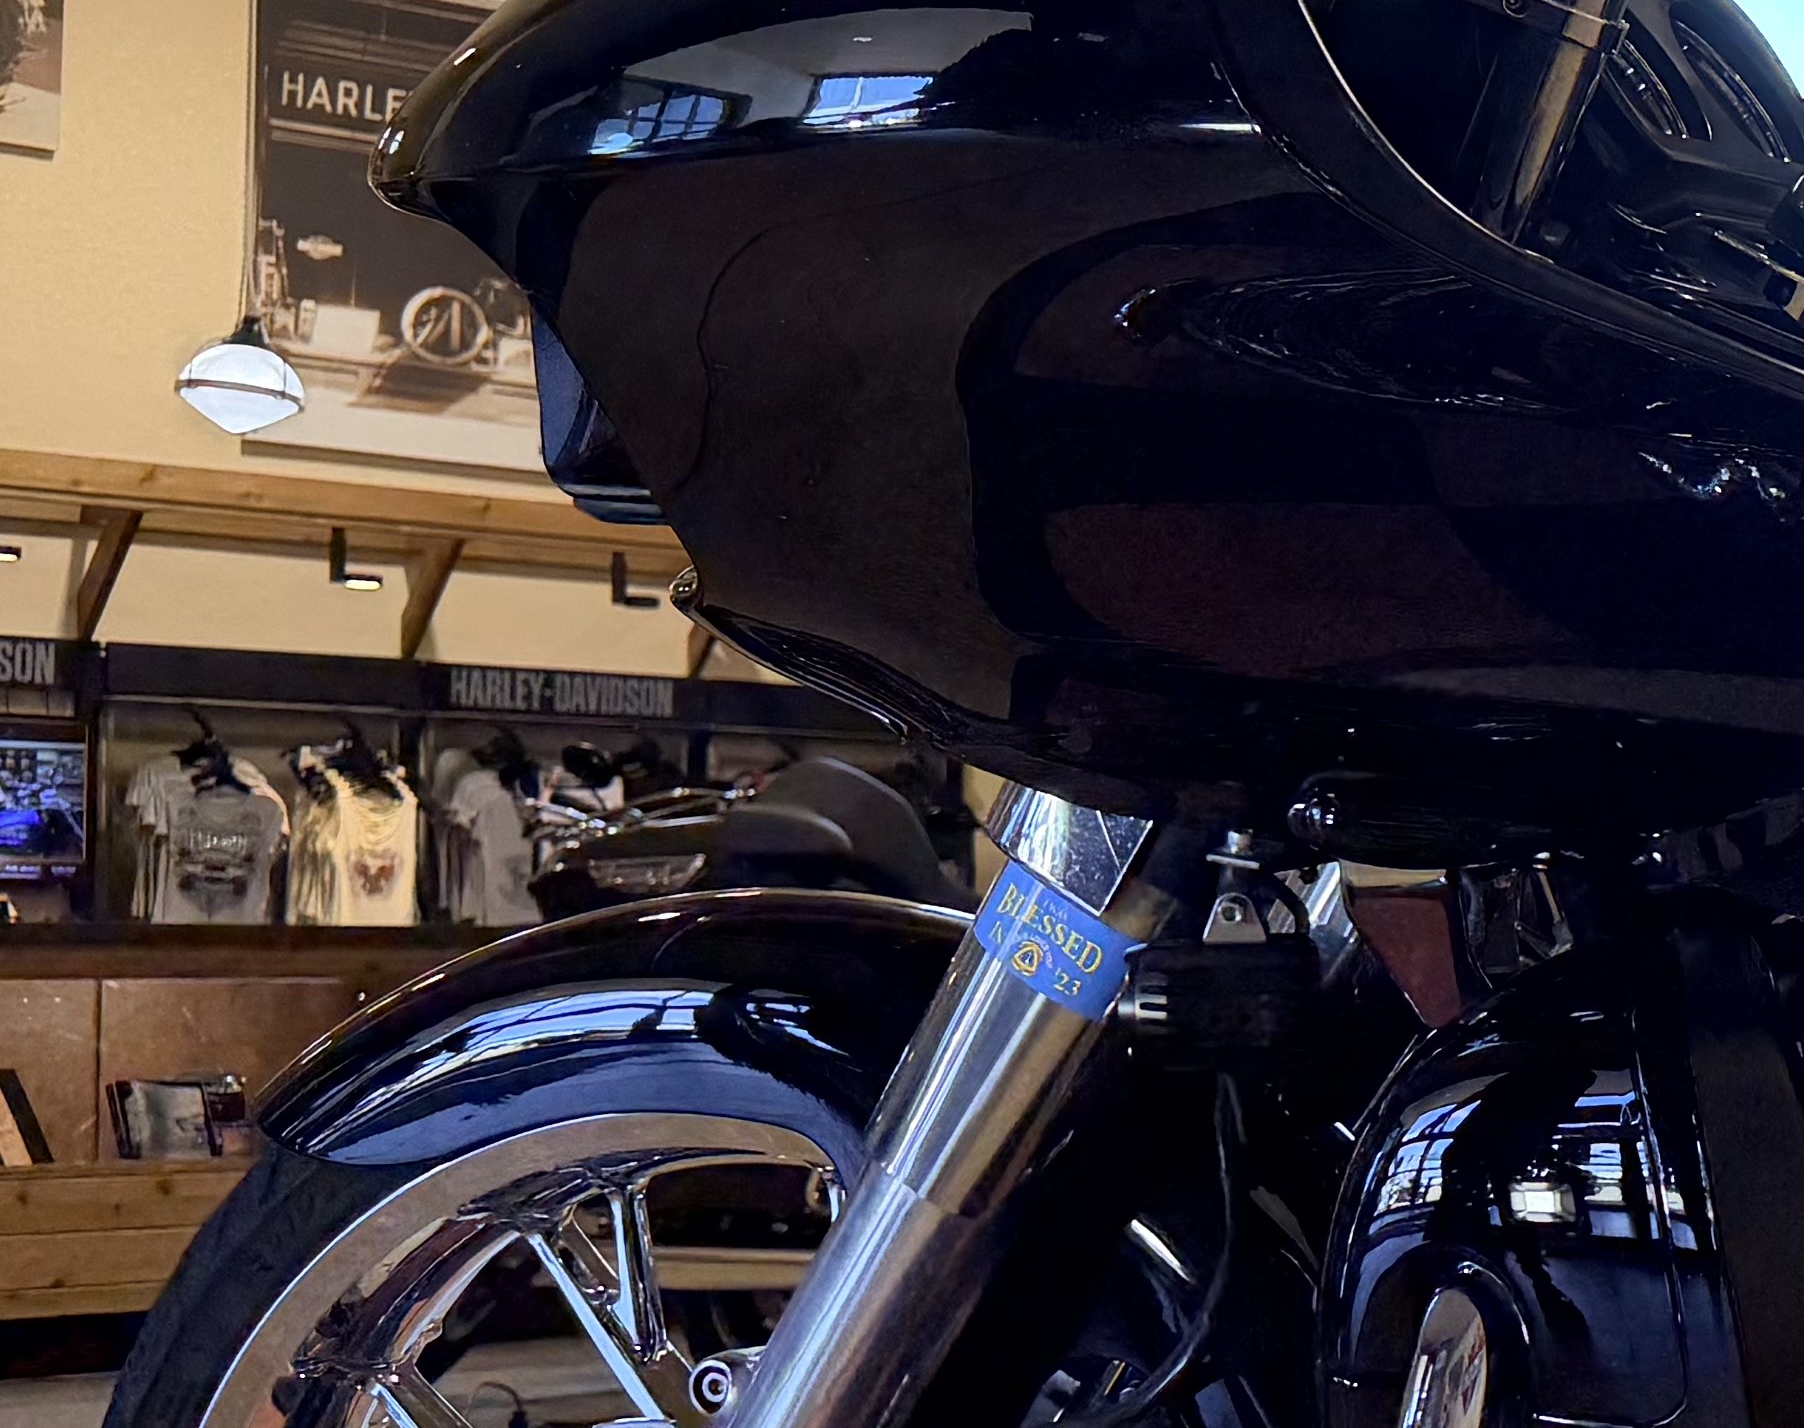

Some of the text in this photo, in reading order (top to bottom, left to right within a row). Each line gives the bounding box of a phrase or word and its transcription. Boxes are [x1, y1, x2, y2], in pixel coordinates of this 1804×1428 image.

[281, 70, 414, 123] HARLE
[450, 668, 674, 718] HARLEY-DAVIDSON
[996, 882, 1103, 974] BLESSED
